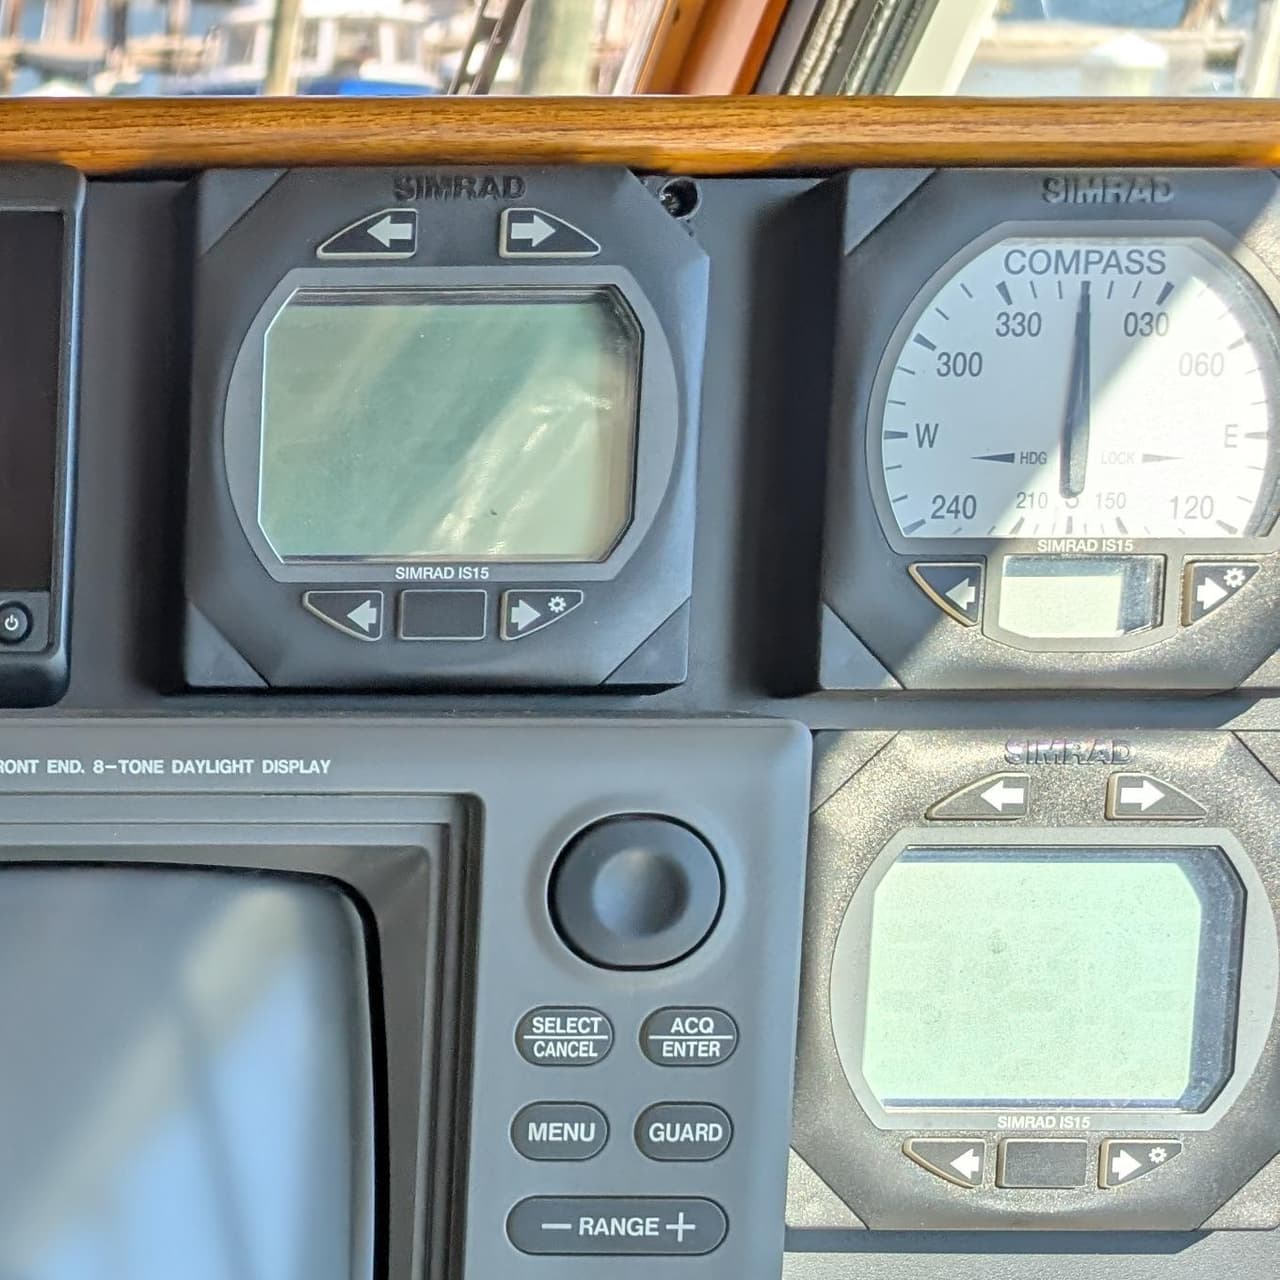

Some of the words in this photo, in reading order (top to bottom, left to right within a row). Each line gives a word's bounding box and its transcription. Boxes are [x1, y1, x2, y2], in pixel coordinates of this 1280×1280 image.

[392, 174, 526, 202] SIMRAD
[1041, 176, 1173, 205] SIMRAD
[1004, 249, 1166, 275] COMPASS
[996, 312, 1041, 337] 330
[1124, 312, 1169, 337] 030
[936, 352, 982, 378] 300
[1179, 352, 1224, 378] 060
[915, 424, 939, 448] W
[1224, 425, 1238, 448] E
[1020, 452, 1047, 465] HDG
[1101, 452, 1135, 464] LOCK
[931, 495, 977, 520] 240
[1016, 492, 1048, 509] 210
[1095, 492, 1126, 509] 150
[1170, 495, 1214, 520] 120
[1038, 540, 1098, 552] SIMRAD
[1102, 540, 1133, 551] IS15
[395, 566, 455, 580] SIMRAD
[458, 566, 489, 580] IS15
[1004, 737, 1135, 766] SIMRAD
[47, 760, 85, 774] END.
[172, 759, 254, 774] DAYLIGHT
[262, 759, 331, 774] DISPLAY
[532, 1017, 602, 1034] SELECT
[671, 1017, 714, 1034] ACQ
[534, 1041, 598, 1057] CANCEL
[663, 1041, 720, 1057] ENTER
[997, 1115, 1056, 1129] SIMRAD
[1059, 1115, 1091, 1129] IS15
[528, 1123, 595, 1142] MENU
[649, 1123, 723, 1142] GUARD
[579, 1217, 660, 1236] RANGE
